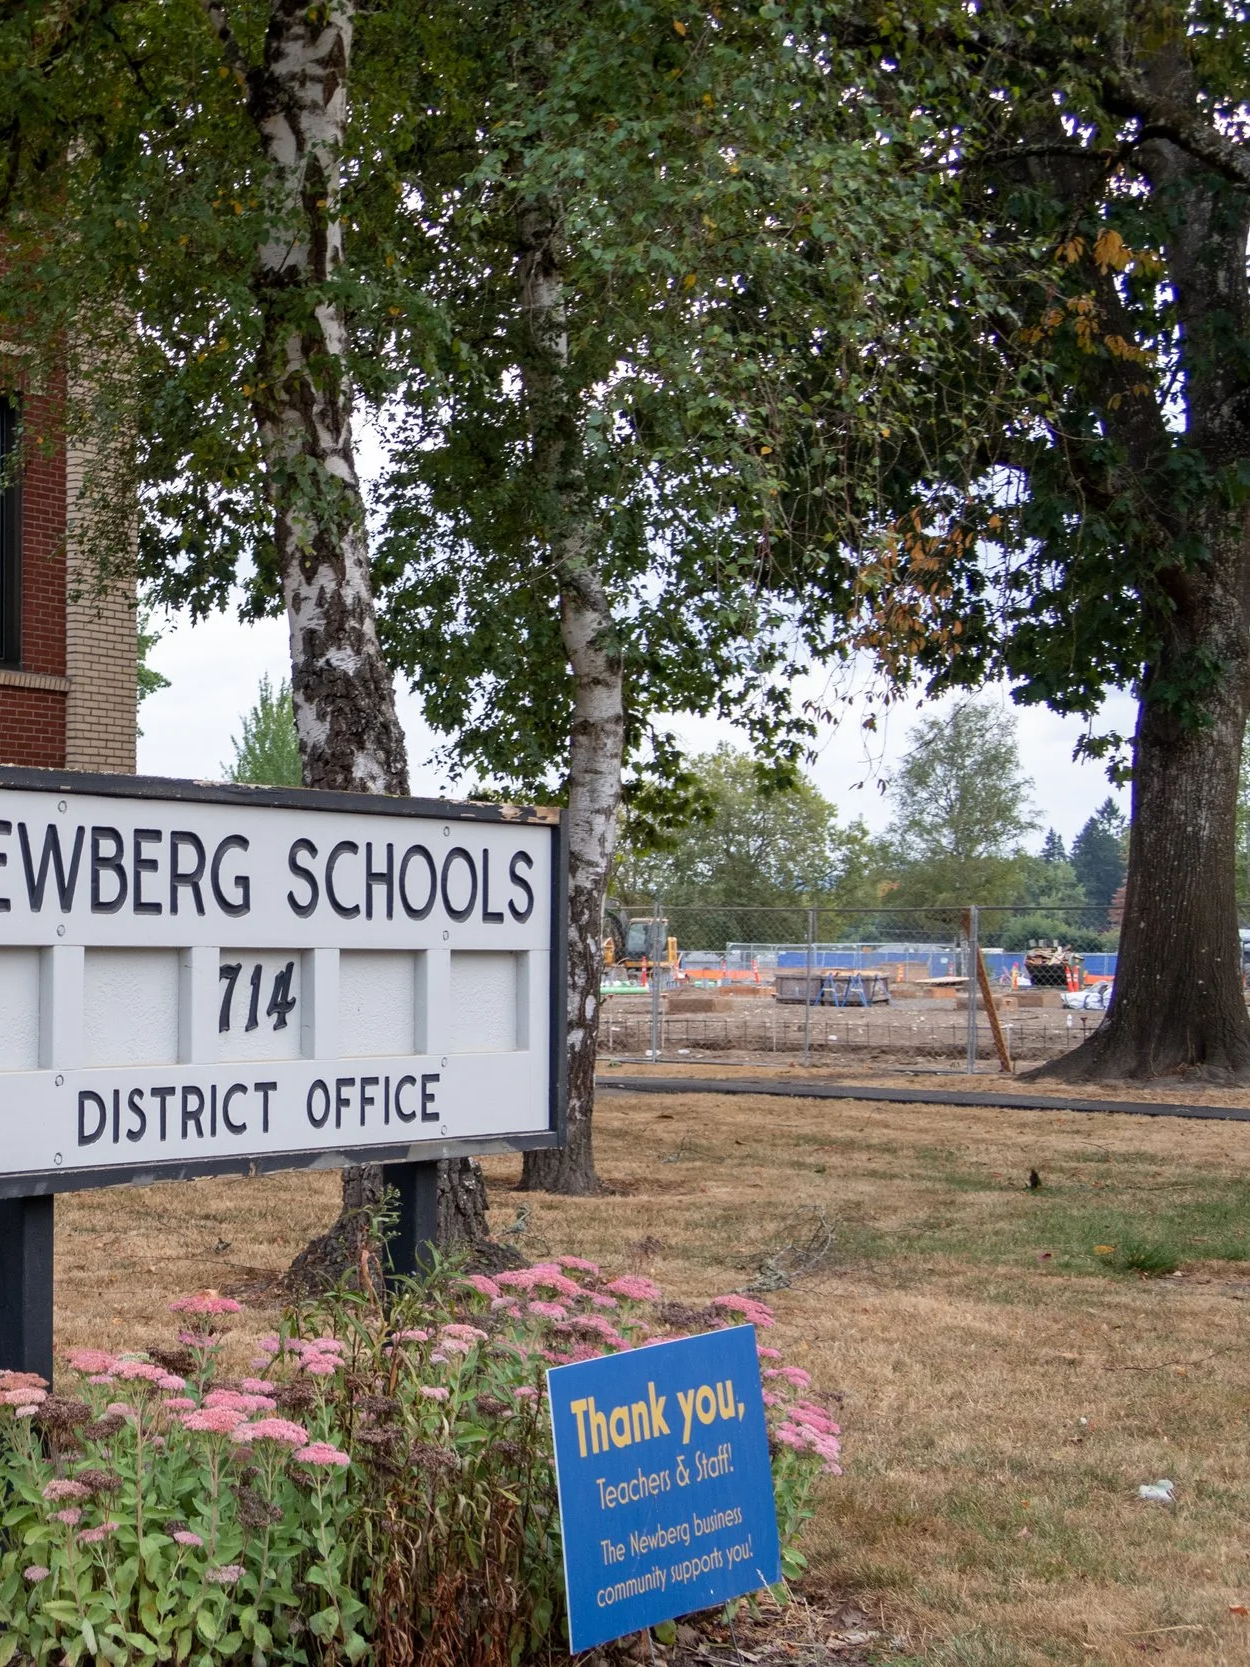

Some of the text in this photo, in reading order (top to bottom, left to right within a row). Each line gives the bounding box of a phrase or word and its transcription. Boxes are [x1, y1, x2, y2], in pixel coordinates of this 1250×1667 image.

[287, 837, 535, 924] SCHOOLS
[218, 961, 297, 1033] 714
[77, 1073, 442, 1147] DISTRICT OFFICE
[570, 1380, 746, 1458] Thank you,
[596, 1442, 734, 1510] Teachers & Staff!
[597, 1534, 754, 1608] community supports you!
[600, 1506, 743, 1566] The Newberg business
